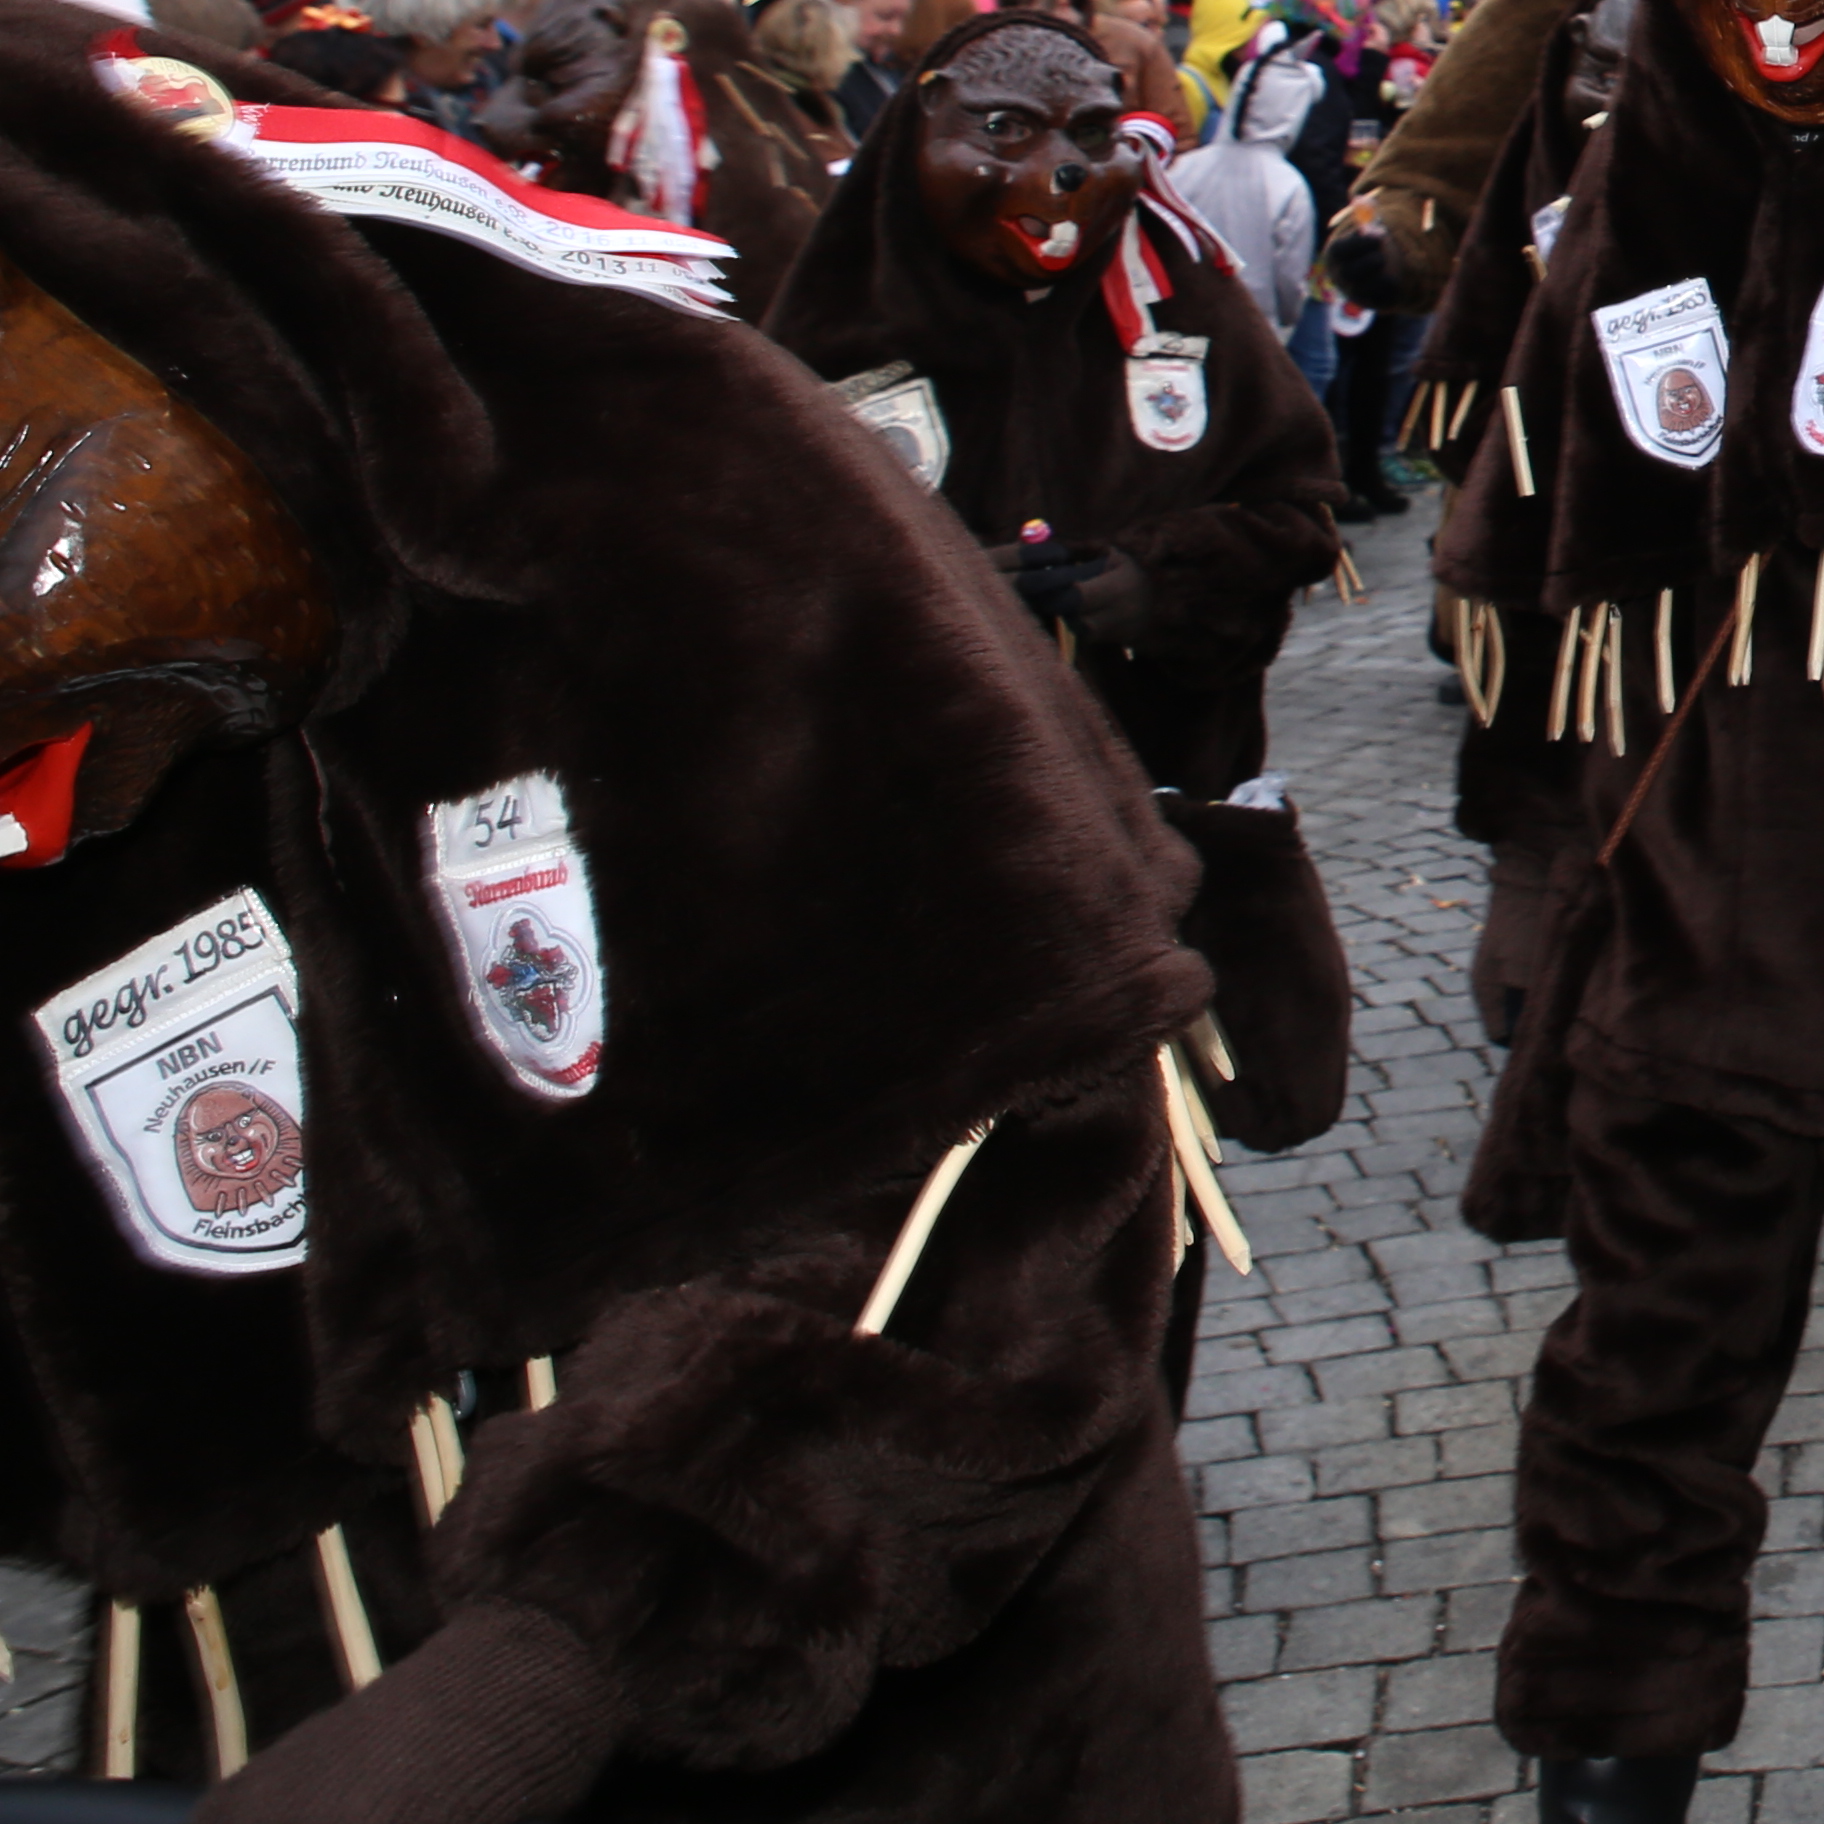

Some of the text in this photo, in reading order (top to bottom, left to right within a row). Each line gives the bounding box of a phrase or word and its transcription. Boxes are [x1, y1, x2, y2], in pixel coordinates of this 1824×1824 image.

[373, 150, 490, 201] Neuhausen
[561, 250, 628, 276] 2013
[635, 260, 660, 274] 11
[474, 794, 522, 849] 54
[63, 911, 267, 1057] gegr. 1985
[156, 1031, 224, 1081] NBN
